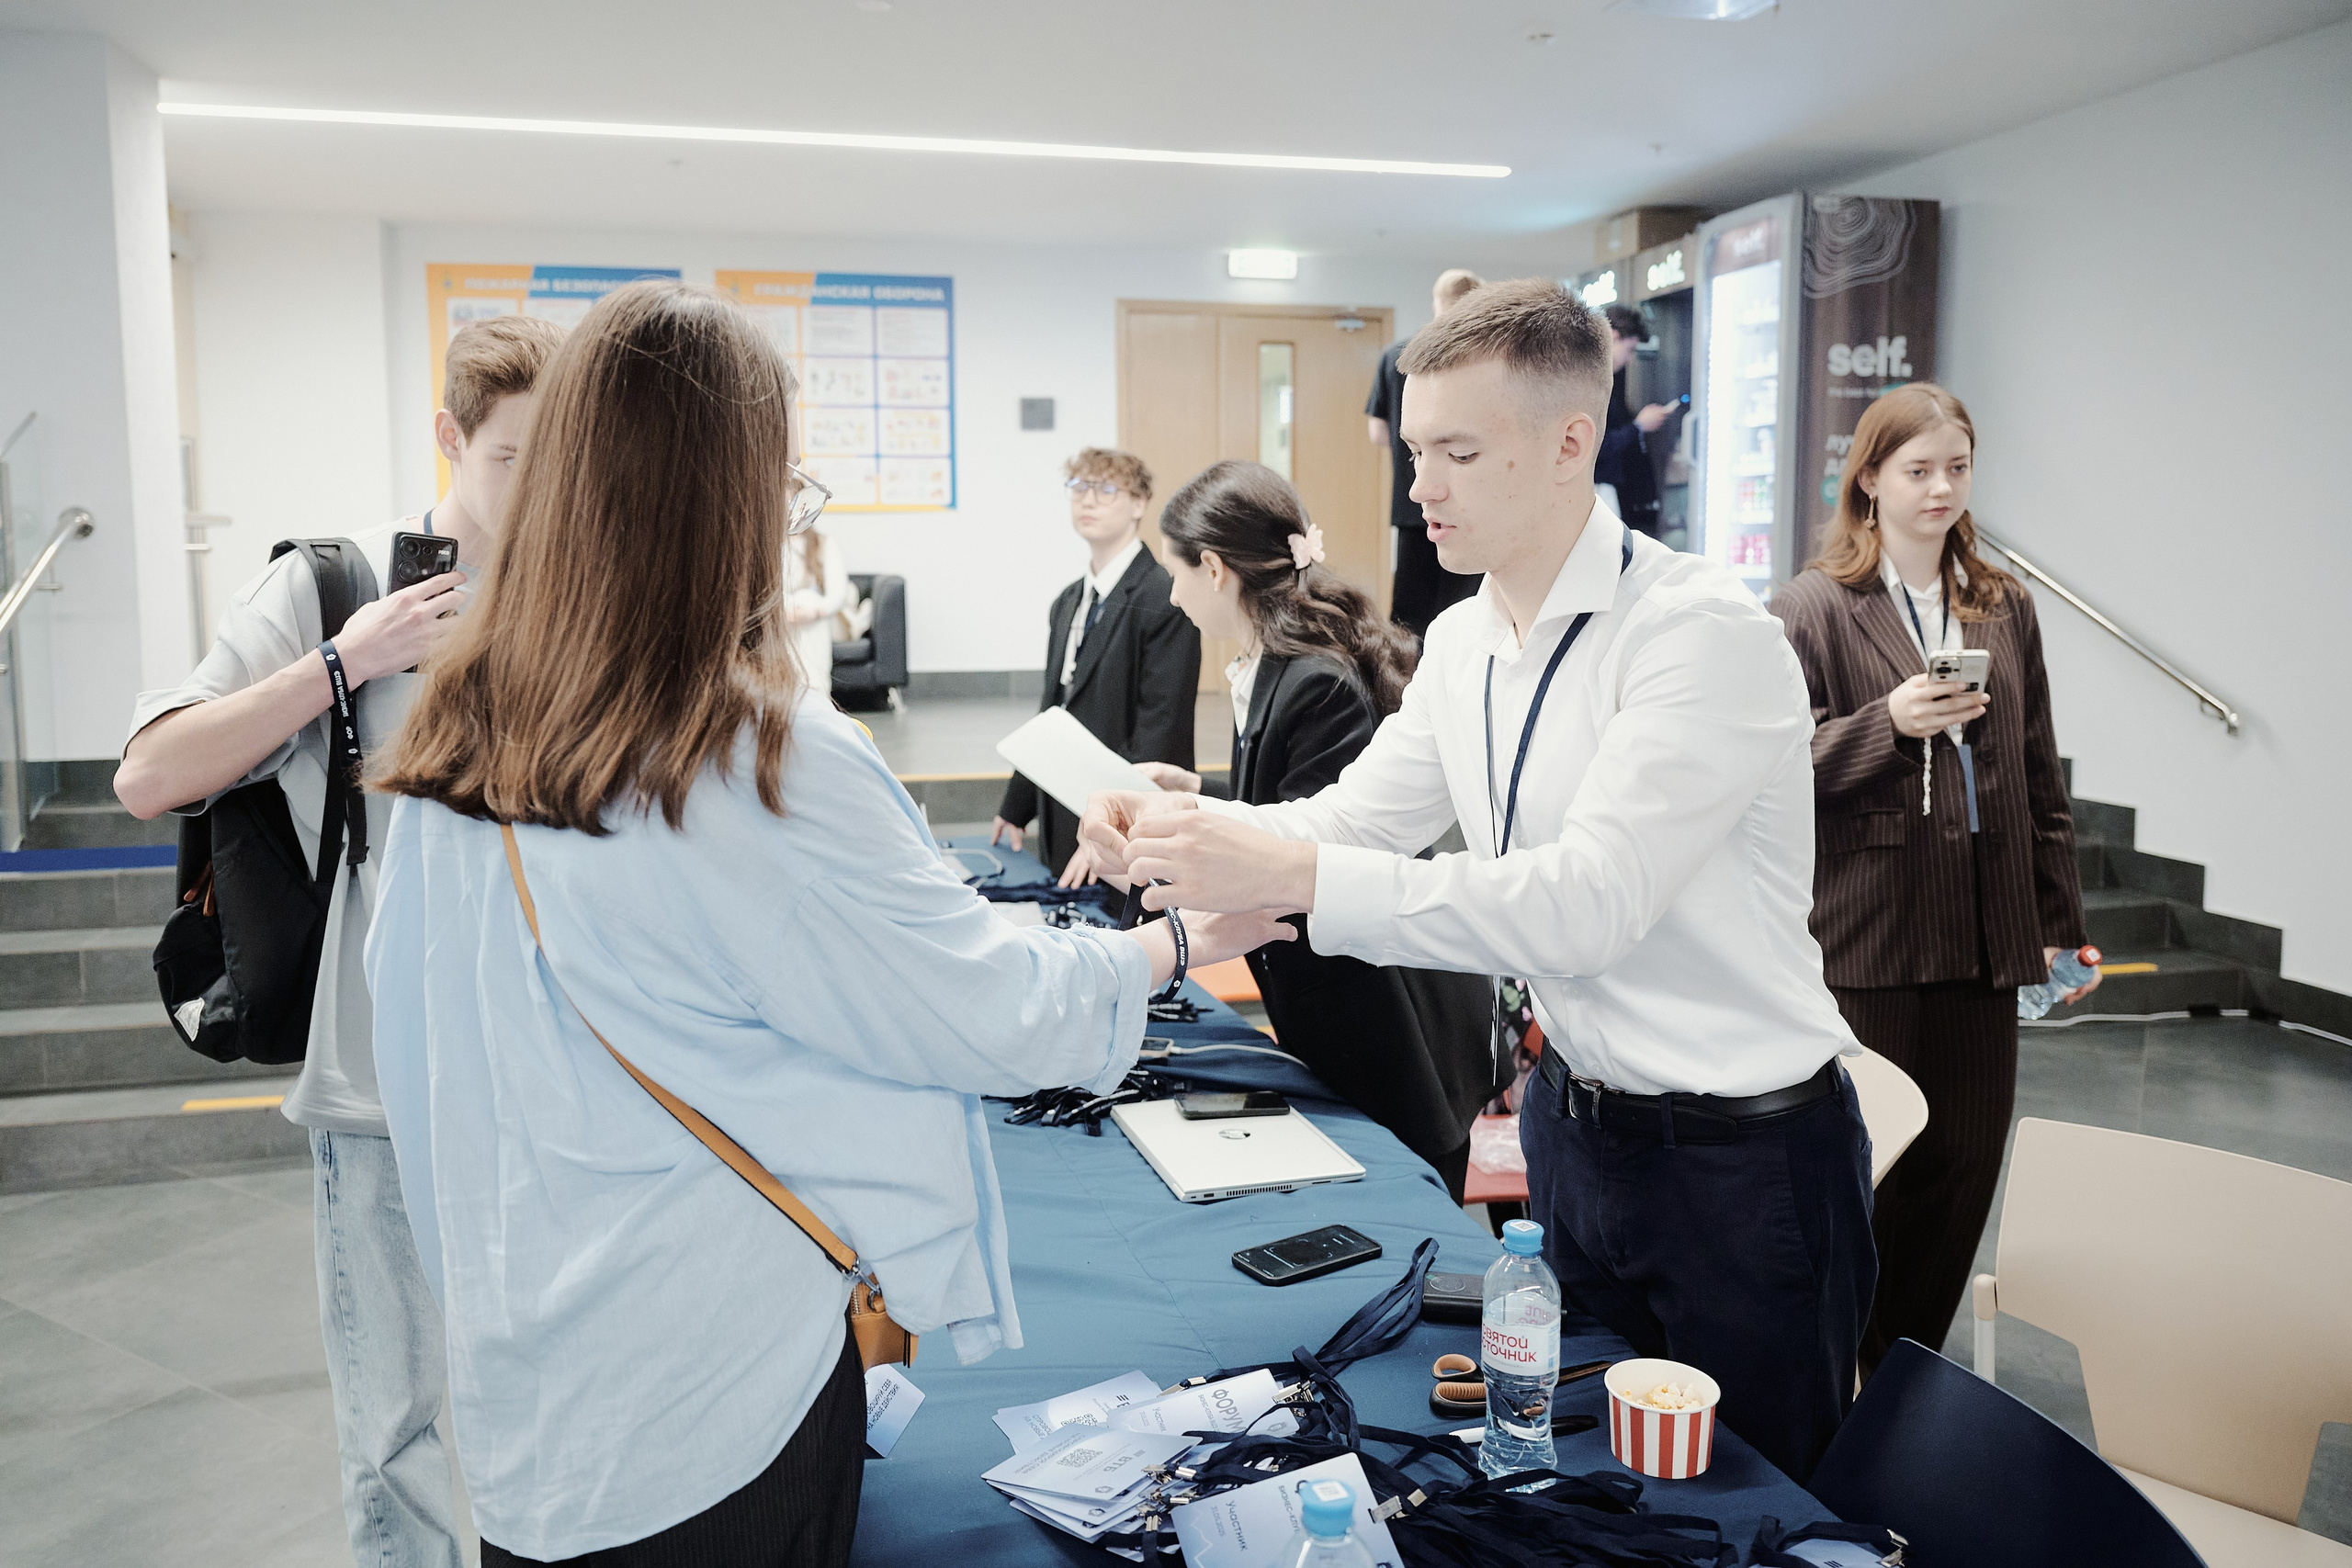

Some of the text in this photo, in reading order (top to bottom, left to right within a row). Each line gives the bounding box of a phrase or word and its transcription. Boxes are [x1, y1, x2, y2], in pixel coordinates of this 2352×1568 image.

[1827, 335, 1913, 378] self.
[345, 726, 354, 740] ФОР
[1167, 906, 1184, 945] НЕС-КЛУБА
[1483, 1337, 1537, 1362] СТОЧНИК
[866, 1379, 892, 1416] ОВОЦИРУЙ СЕБЯ
[872, 1405, 886, 1425] НОВЫЕ
[1211, 1388, 1247, 1434] ФОРУМ
[1103, 1455, 1133, 1472] ВТБ
[1226, 1500, 1249, 1551] Участник
[1277, 1484, 1301, 1533] БИЗНЕС-КЛУ
